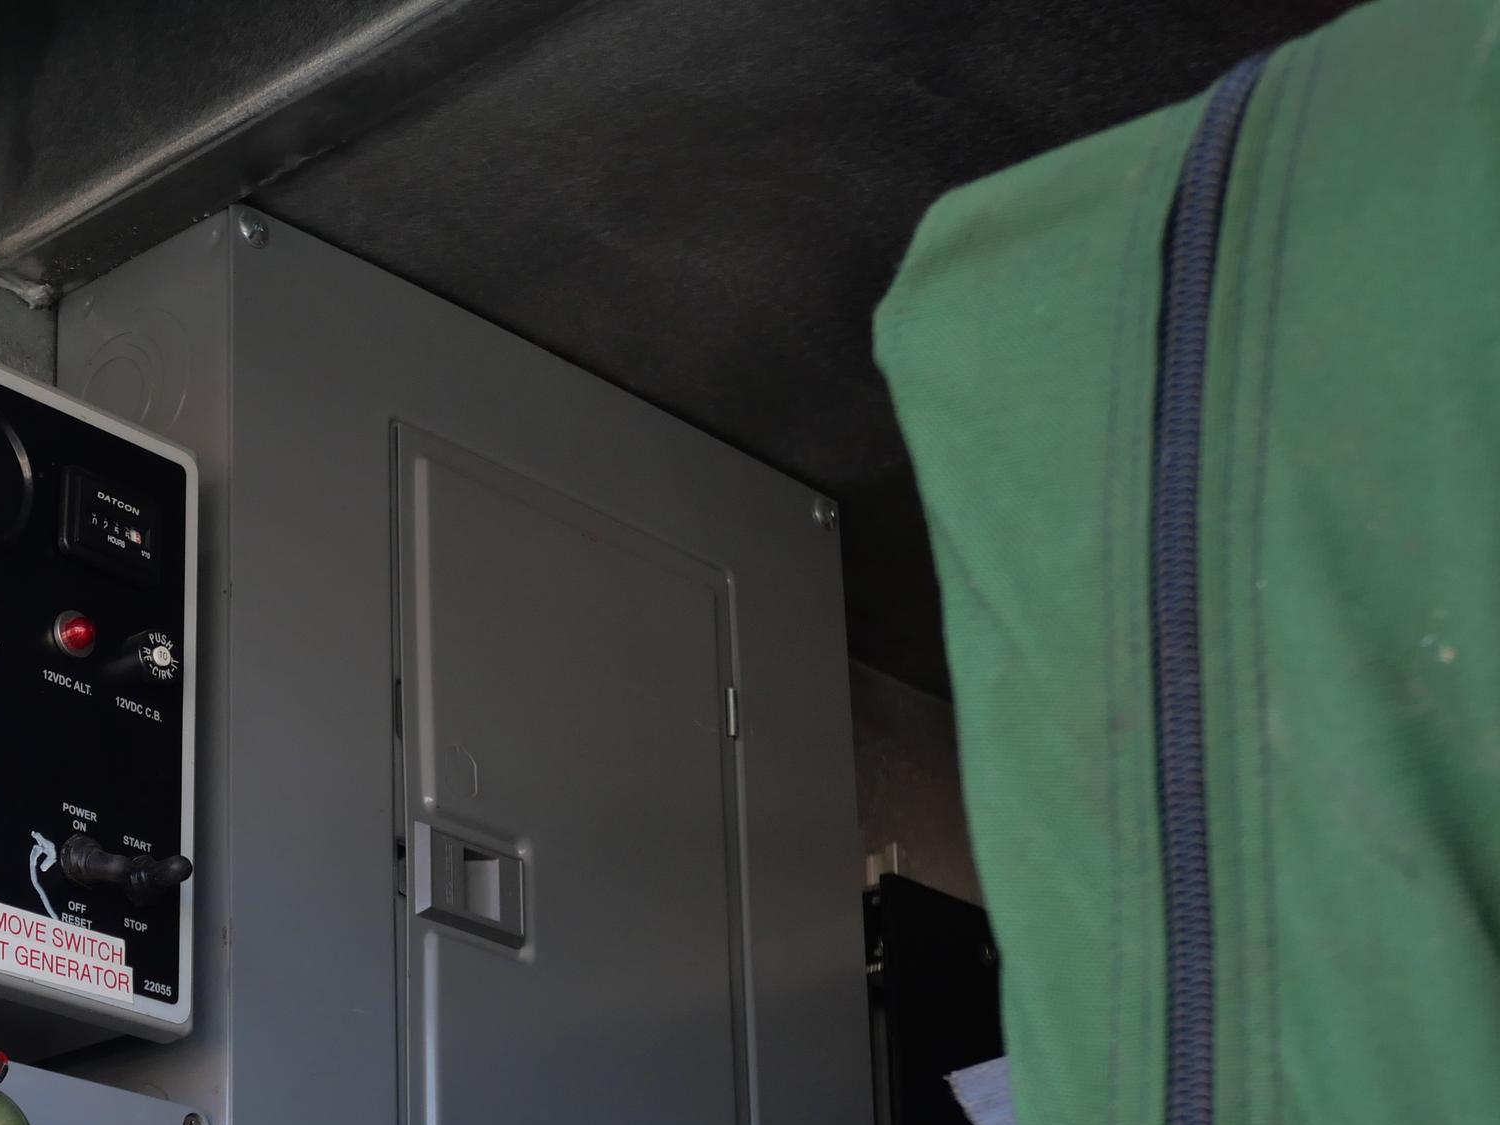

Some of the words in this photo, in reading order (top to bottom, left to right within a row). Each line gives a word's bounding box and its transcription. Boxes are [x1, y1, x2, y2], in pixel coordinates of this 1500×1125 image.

[97, 491, 140, 516] DATCON
[107, 534, 126, 549] HOURS
[149, 632, 174, 650] PUSH
[157, 650, 168, 662] 10
[43, 669, 72, 688] 12VDC
[73, 675, 93, 696] ALT.
[115, 696, 143, 715] 12VDC
[145, 707, 162, 722] C.B.
[62, 802, 97, 822] POWER
[73, 820, 87, 832] ON
[123, 835, 152, 853] START
[68, 901, 87, 914] OFF
[61, 912, 93, 930] RESET
[123, 917, 148, 933] STOP
[52, 927, 123, 966] SWITCH
[15, 945, 131, 994] GENERATOR
[143, 979, 172, 997] 22055
